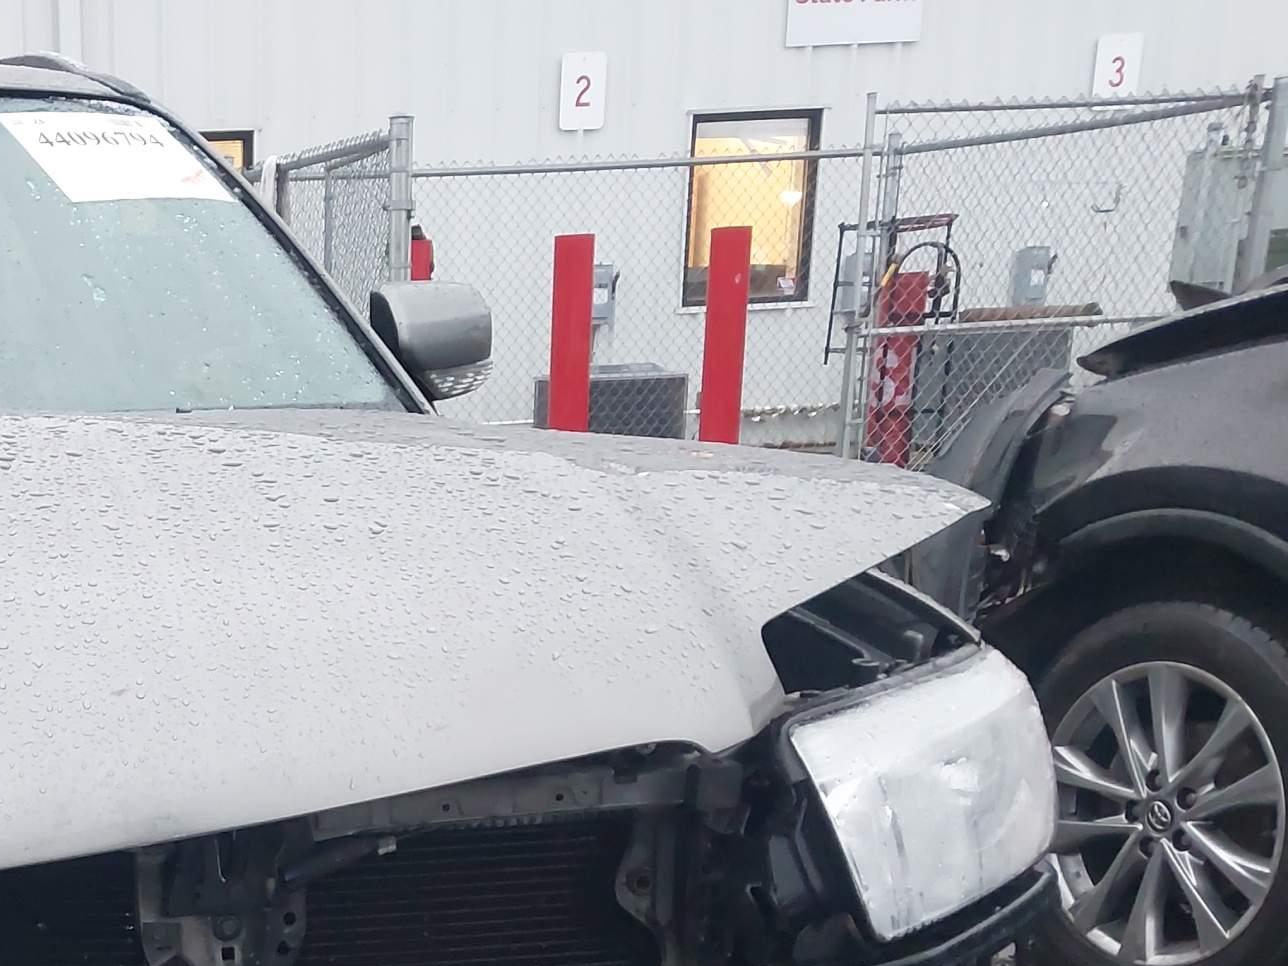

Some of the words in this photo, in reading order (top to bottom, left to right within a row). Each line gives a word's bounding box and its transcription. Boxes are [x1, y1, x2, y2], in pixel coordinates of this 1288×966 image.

[1109, 56, 1125, 87] 3
[575, 75, 591, 107] 2
[38, 131, 164, 148] 44096794
